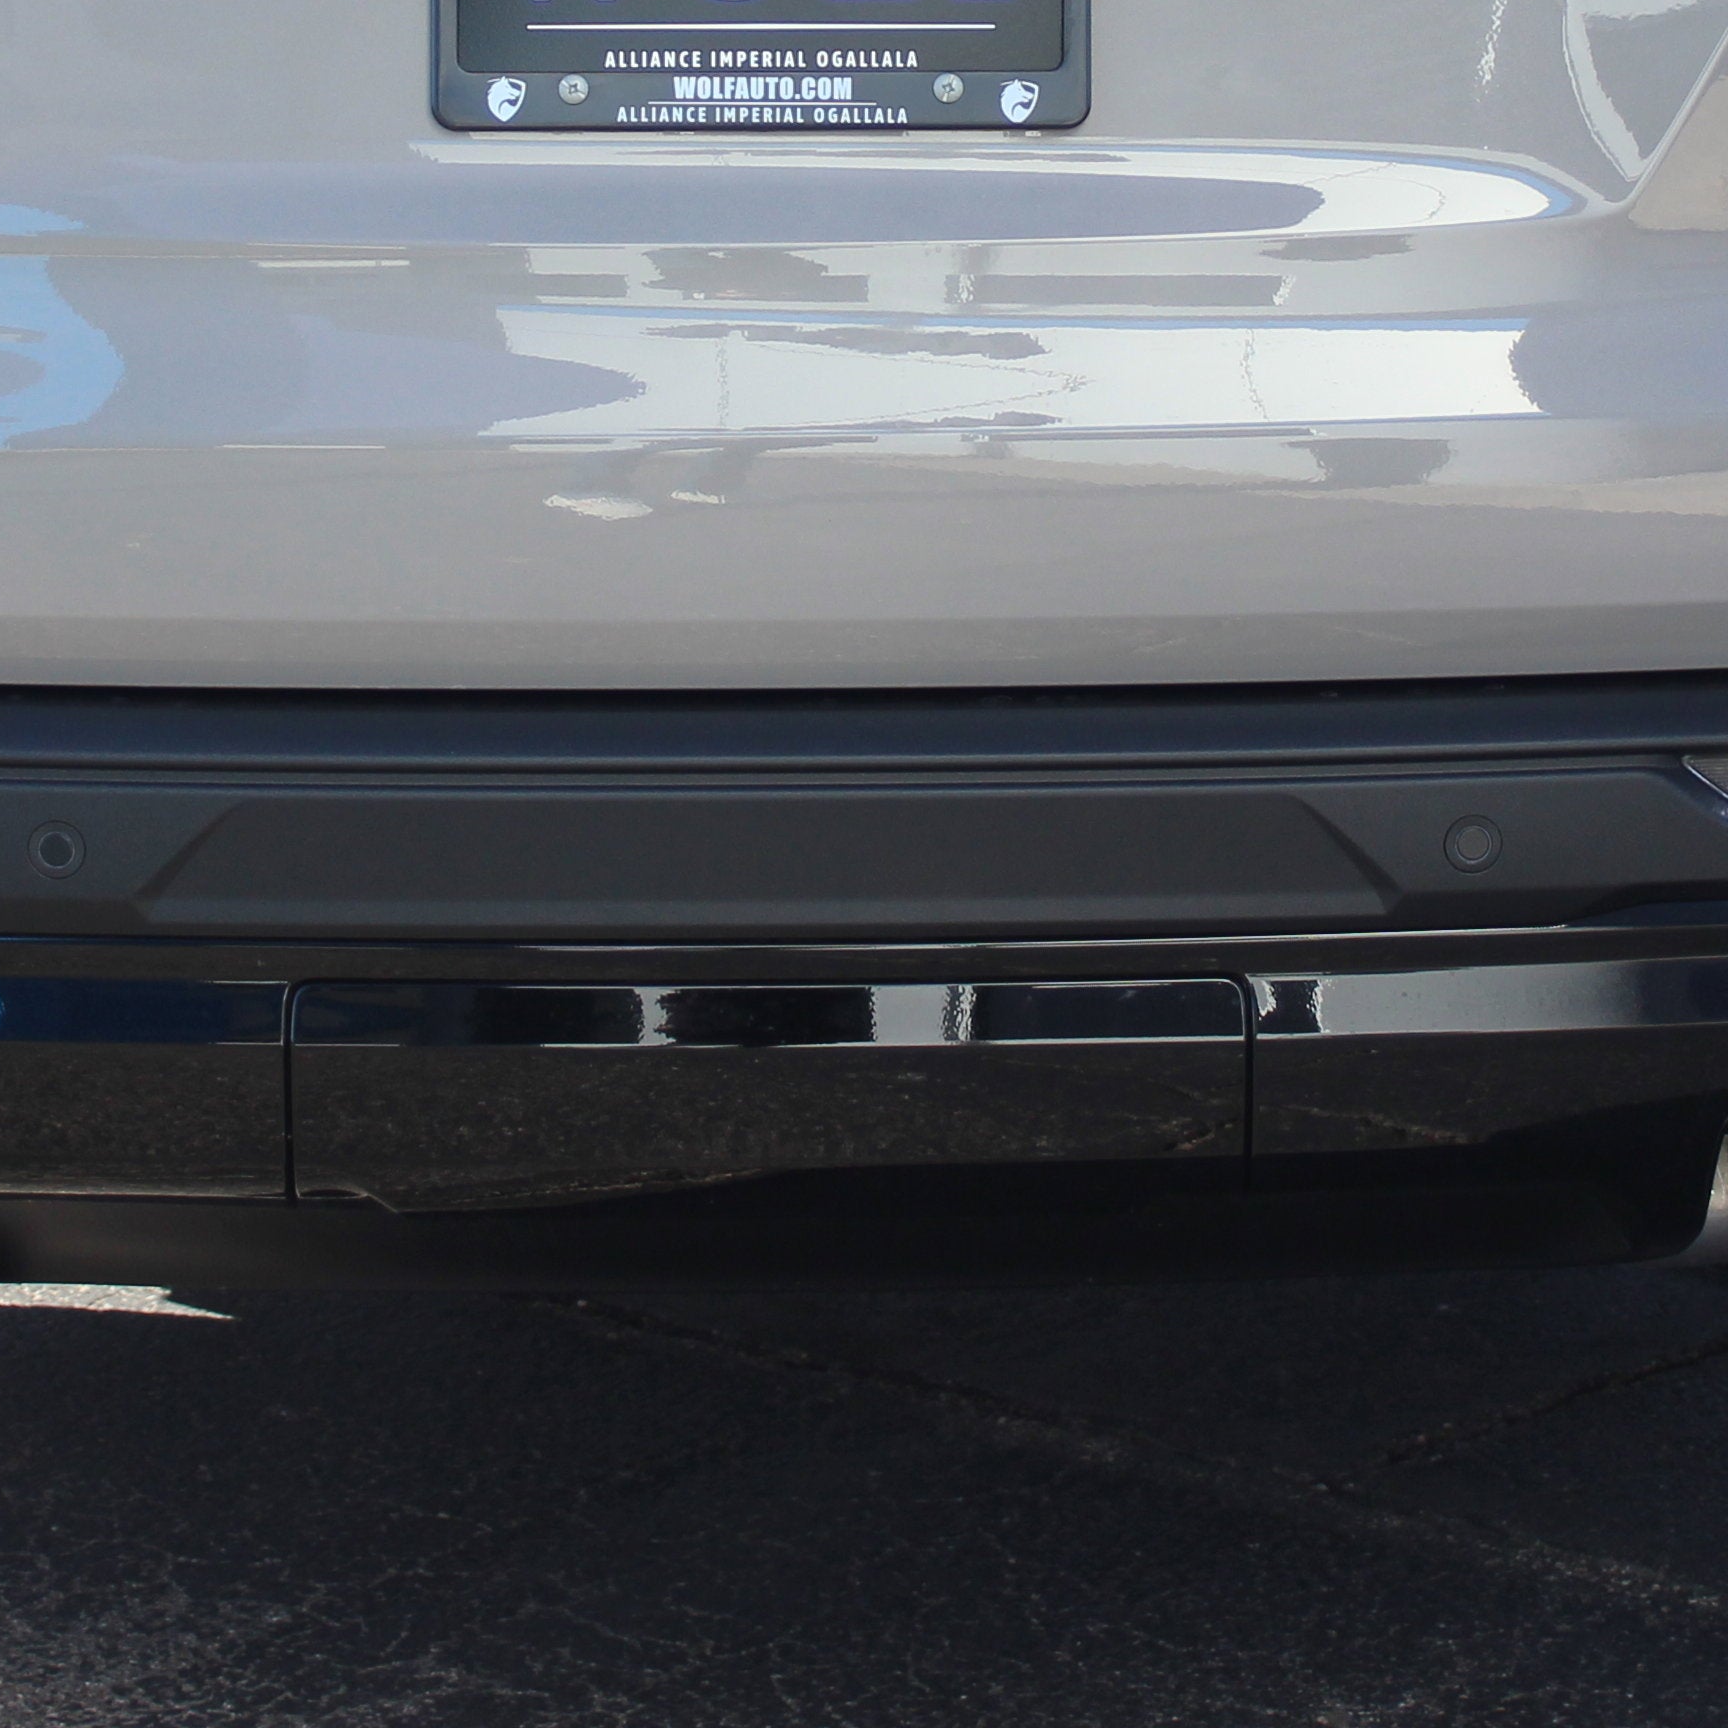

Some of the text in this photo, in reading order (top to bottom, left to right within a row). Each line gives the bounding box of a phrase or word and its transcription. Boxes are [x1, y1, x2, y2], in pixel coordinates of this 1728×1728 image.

[604, 50, 918, 69] ALLIANCE IMPERIAL OGALLALA
[674, 76, 852, 101] WOLFAUTO.COM
[616, 106, 908, 125] ALLIANCE IMPERIAL OGALLALA
